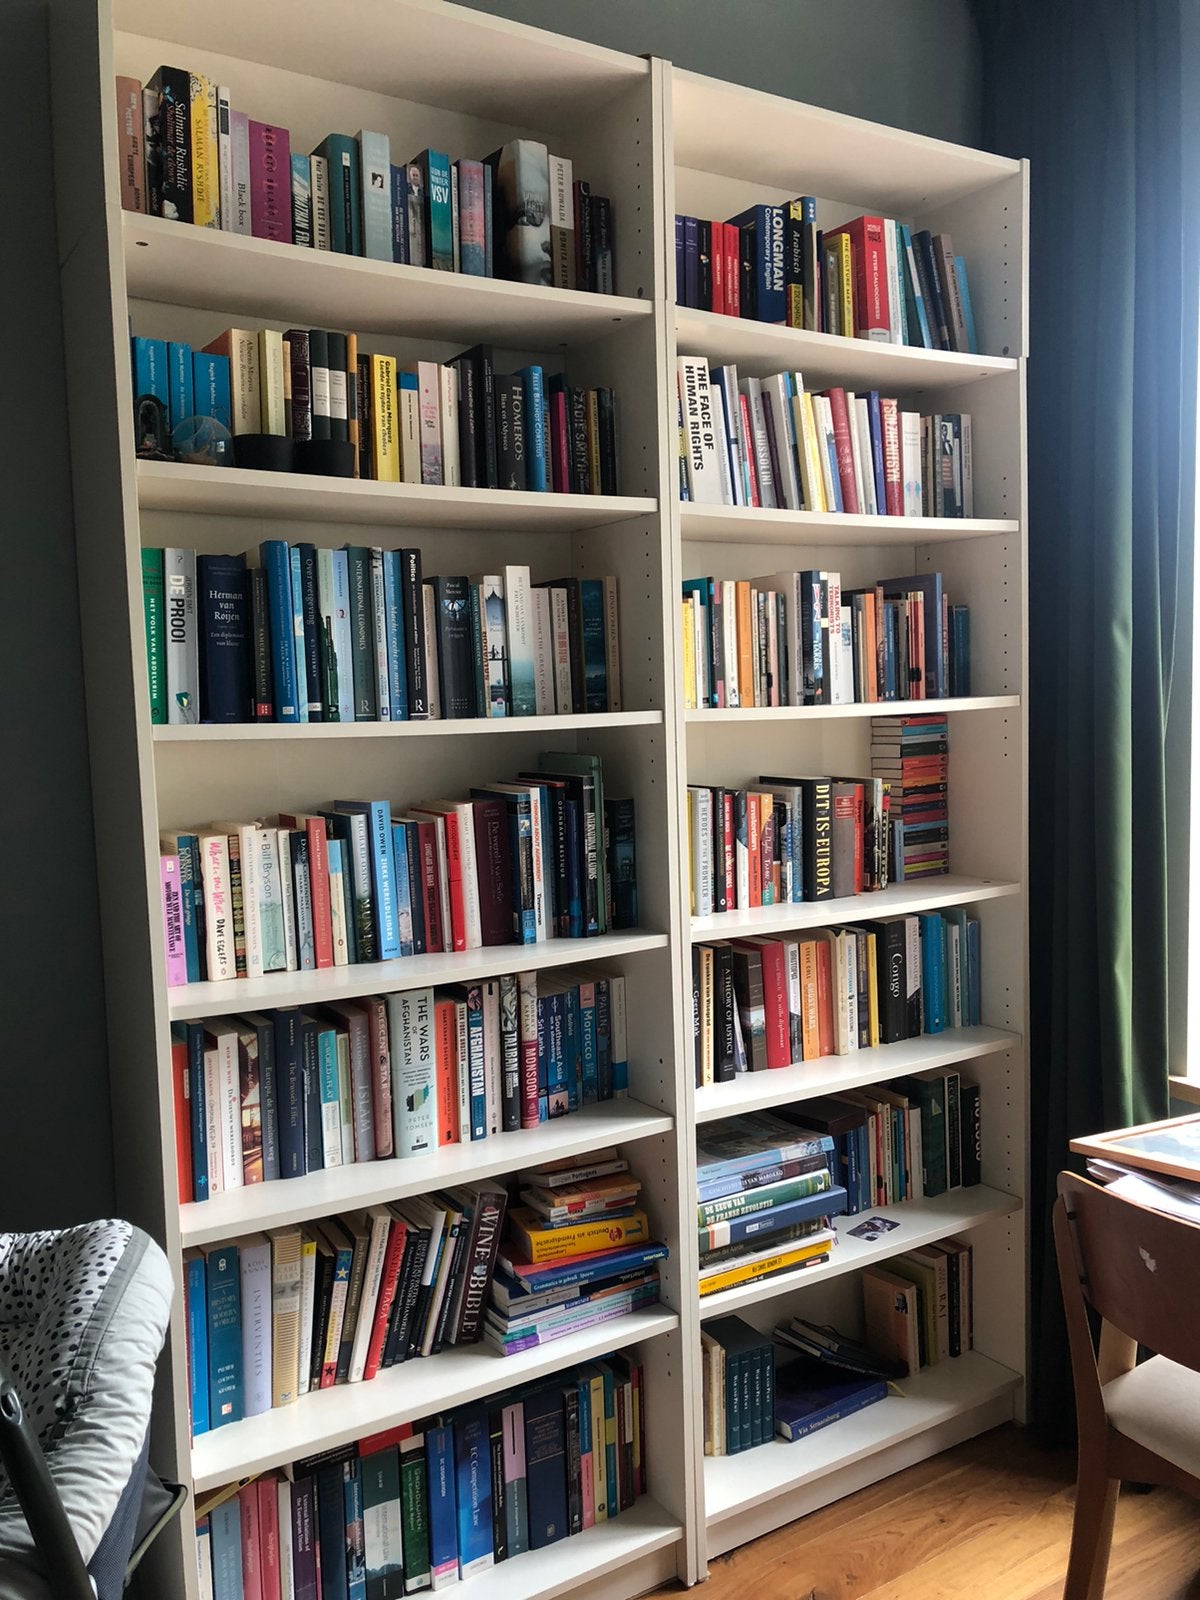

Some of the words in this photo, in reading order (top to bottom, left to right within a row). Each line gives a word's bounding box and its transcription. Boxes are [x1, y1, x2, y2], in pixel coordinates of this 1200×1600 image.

[175, 101, 187, 143] Salman
[176, 147, 187, 191] Rushdie
[556, 163, 565, 187] PETER
[237, 183, 246, 207] Black
[431, 183, 448, 204] VSV
[238, 209, 246, 226] box
[773, 208, 783, 292] LONGMAN
[792, 230, 801, 274] Arabisch
[697, 365, 707, 392] THE
[512, 385, 524, 461] HOMEROS
[573, 394, 585, 431] ZADIE
[685, 365, 698, 416] HUMAN
[692, 421, 703, 472] RIGHTS
[700, 395, 710, 429] FACE
[575, 433, 586, 472] SMITH
[703, 433, 714, 450] OF
[756, 429, 772, 485] MUSSOLINI
[170, 574, 184, 595] DE
[306, 559, 314, 582] Over
[209, 590, 243, 600] Herman
[306, 586, 316, 625] wetgeving
[171, 598, 185, 643] PROOI
[835, 623, 840, 634] TO
[393, 660, 398, 670] en
[816, 784, 830, 809] DIT
[377, 809, 385, 831] DAVID
[491, 821, 499, 834] De
[261, 843, 271, 860] Bill
[379, 833, 387, 856] OWEN
[491, 835, 501, 865] wereld
[185, 847, 193, 881] CARLOS
[262, 863, 273, 898] Bryson
[816, 838, 830, 895] EUROPA
[215, 919, 226, 938] DAVE
[890, 953, 903, 998] Congo
[417, 996, 428, 1022] THE
[599, 996, 607, 1027] PALIN
[726, 1012, 732, 1022] OF
[401, 998, 413, 1065] AFGHANISTAN
[419, 1025, 429, 1062] WARS
[554, 1015, 563, 1060] Southeast
[584, 1010, 593, 1060] Morocco
[289, 1060, 297, 1075] The
[470, 1026, 484, 1096] AFGHANISTAN
[503, 1031, 518, 1072] TALIBAN
[525, 1047, 537, 1099] MONSOON
[555, 1061, 564, 1080] Asia
[266, 1098, 273, 1108] de
[358, 1085, 370, 1136] ISLAM
[266, 1147, 274, 1162] weg
[473, 1209, 500, 1258] WINE
[587, 1228, 609, 1236] Deutsch
[379, 1287, 393, 1320] HAGA
[462, 1276, 488, 1333] BIBLE
[470, 1460, 479, 1509] Competition
